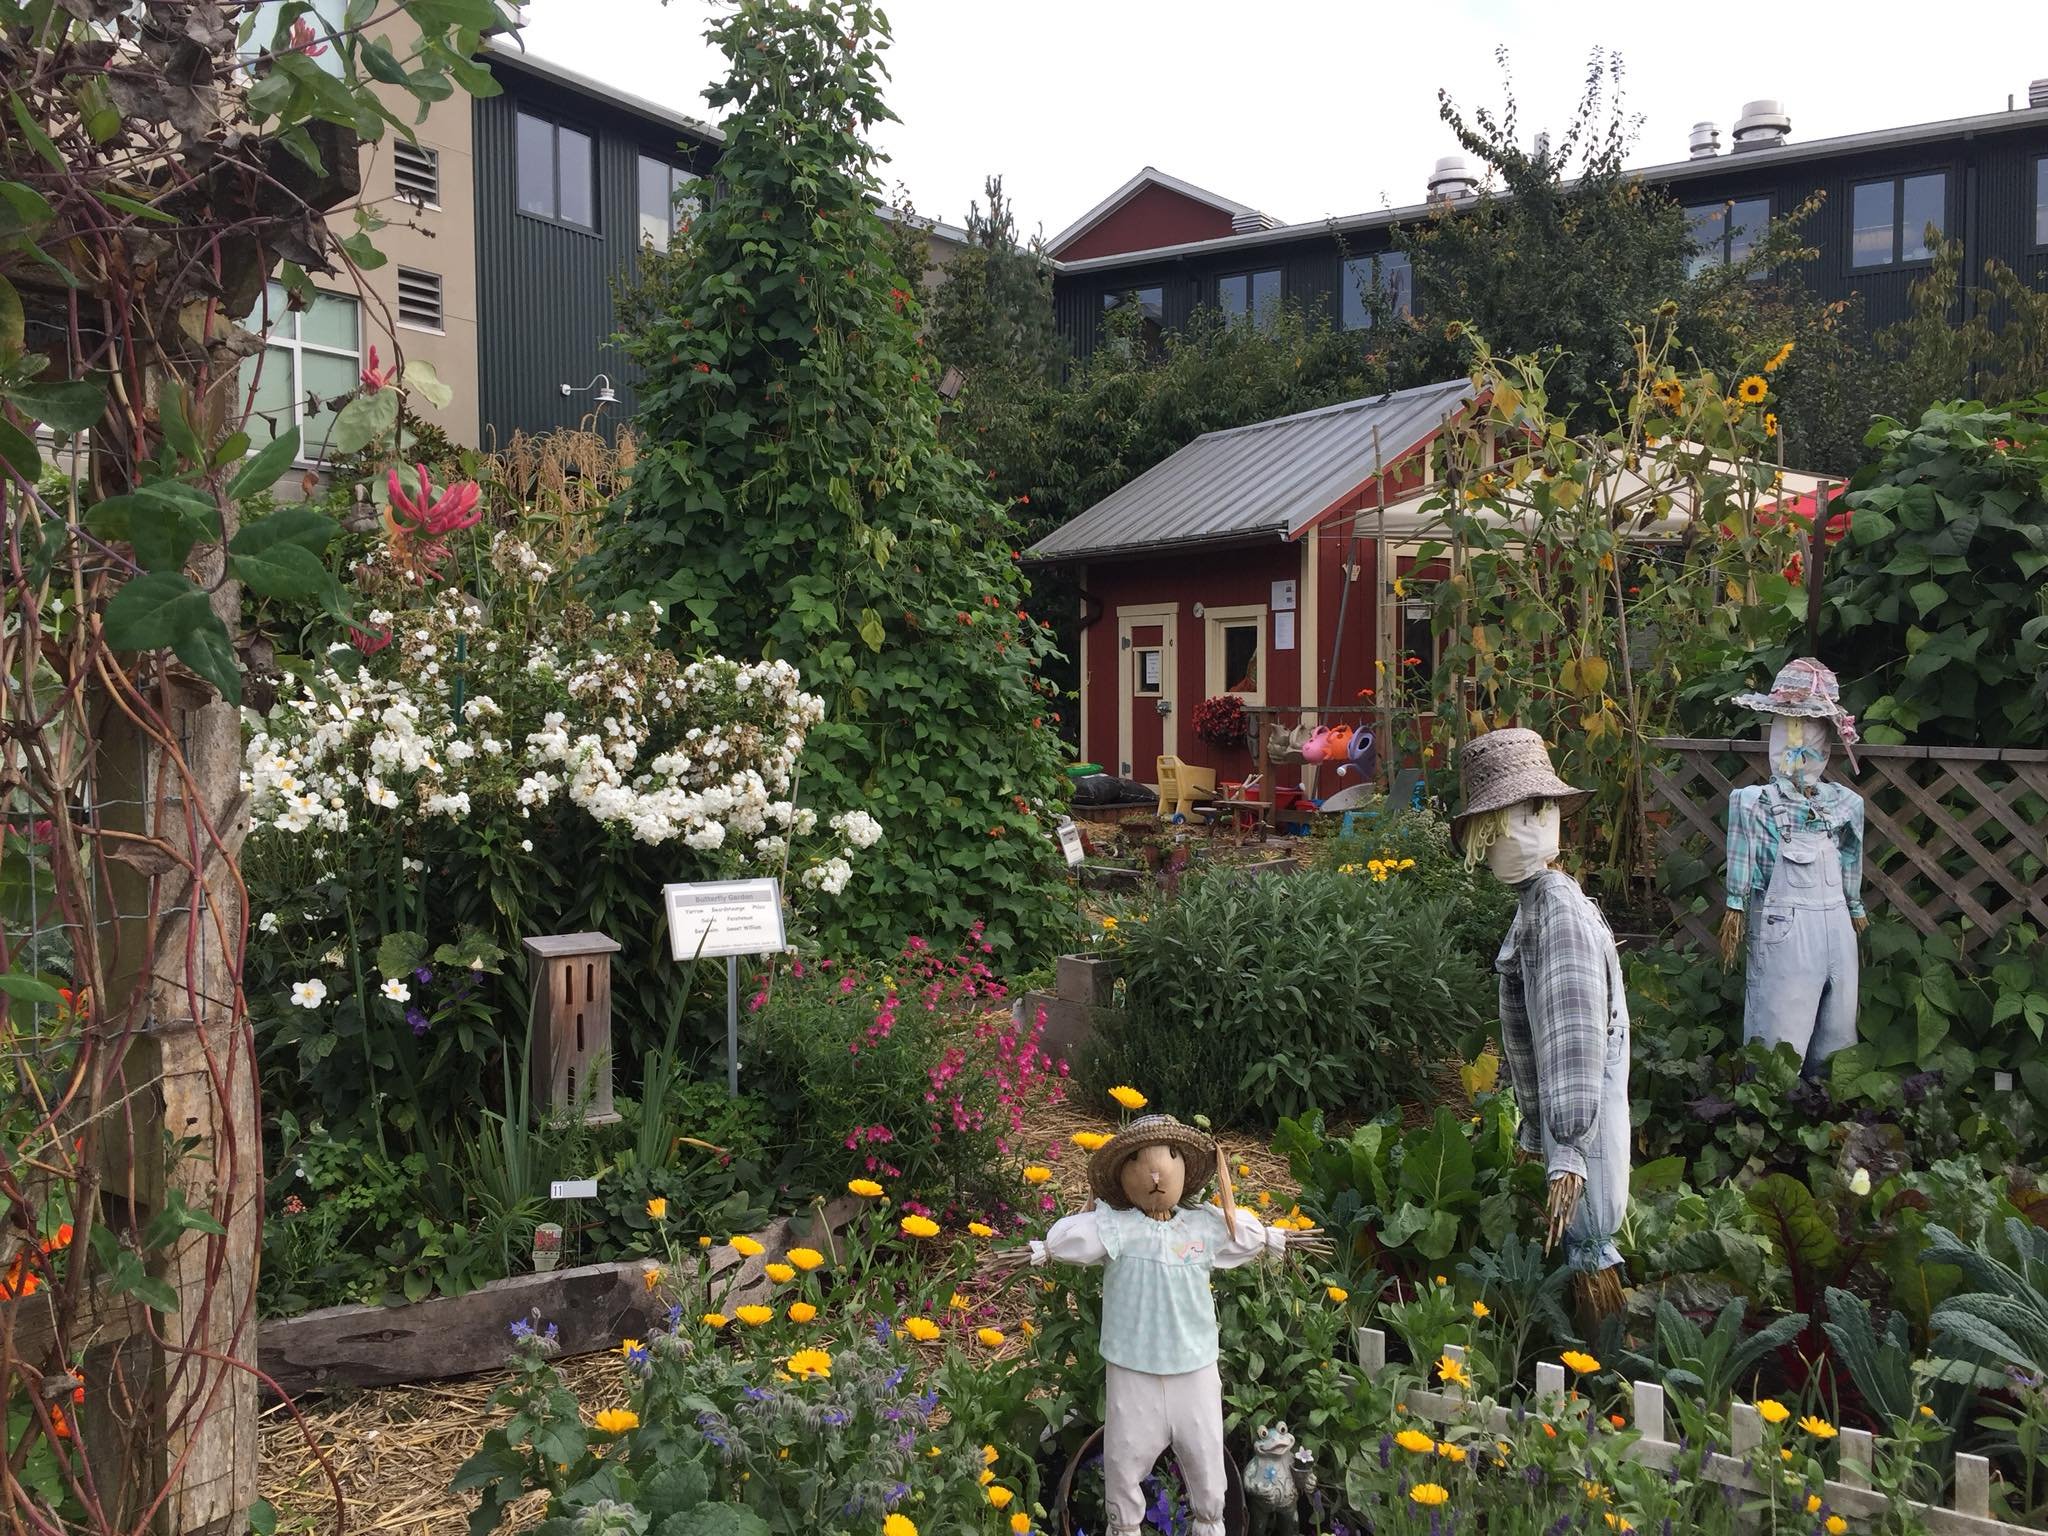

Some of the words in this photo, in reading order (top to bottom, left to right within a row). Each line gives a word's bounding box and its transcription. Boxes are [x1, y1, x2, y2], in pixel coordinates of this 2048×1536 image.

[695, 894, 728, 903] Butterfly
[728, 893, 753, 901] Garden
[553, 1185, 563, 1197] 11
